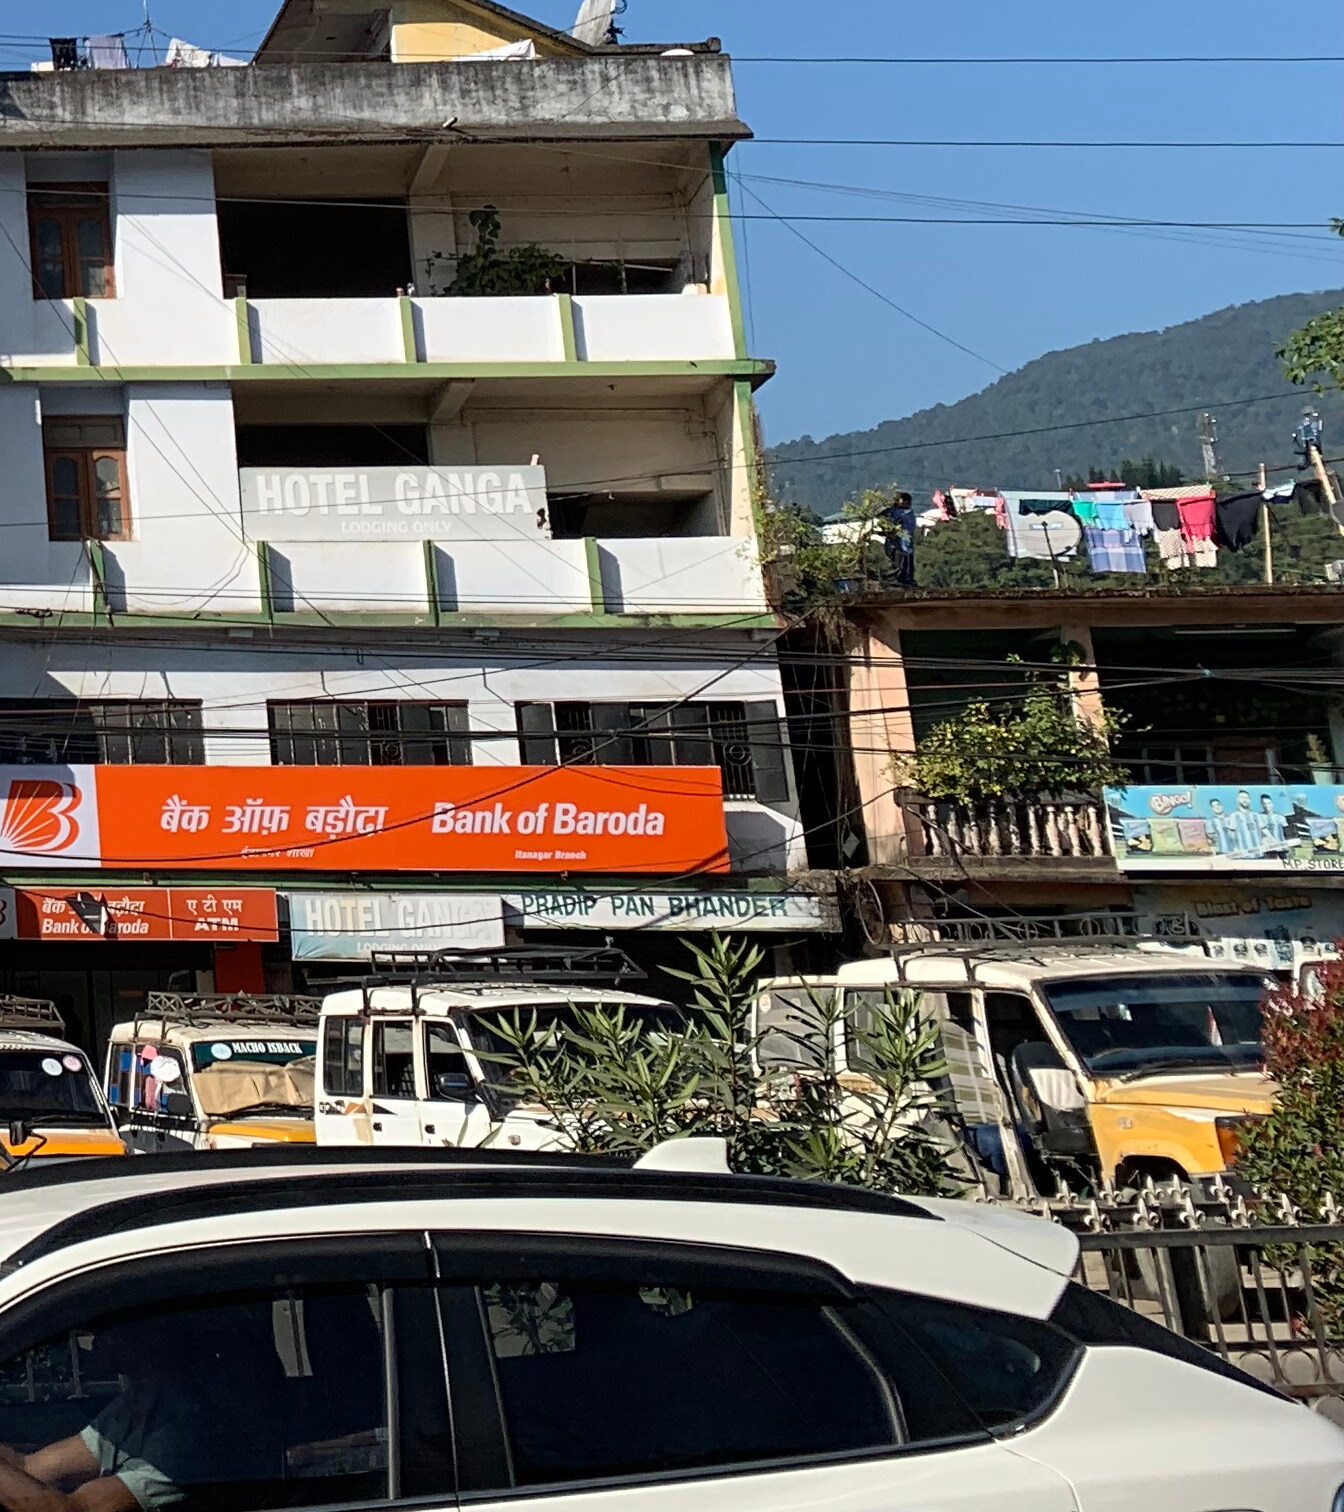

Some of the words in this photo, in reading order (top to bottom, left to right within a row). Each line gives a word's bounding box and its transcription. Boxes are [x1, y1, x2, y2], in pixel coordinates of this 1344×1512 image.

[256, 474, 383, 516] HOTEL
[394, 472, 533, 516] GANGA
[341, 521, 408, 533] LODGING
[412, 520, 452, 533] ONLY
[1151, 791, 1192, 814] BINGO!
[160, 794, 211, 833] बैंक
[222, 798, 291, 836] ऑफ़
[305, 794, 390, 840] बड़ौदा
[432, 802, 514, 834] Bank
[517, 802, 551, 835] of
[553, 804, 666, 836] Baroda
[515, 849, 553, 861] Itanagar
[554, 849, 588, 860] Branch
[42, 896, 65, 913] बैंक
[185, 899, 198, 912] ए
[201, 894, 217, 912] टी
[223, 899, 243, 912] एम
[522, 894, 597, 916] PRADIP
[611, 895, 655, 916] PAN
[668, 895, 789, 918] BHANDER
[1239, 897, 1260, 915] of
[41, 918, 78, 934] Bank
[103, 919, 149, 934] aroda
[194, 917, 240, 932] ATM
[306, 898, 391, 937] HOTEL
[397, 898, 493, 939] GANGA
[357, 941, 408, 953] LODGING
[232, 1041, 266, 1054] MACHO
